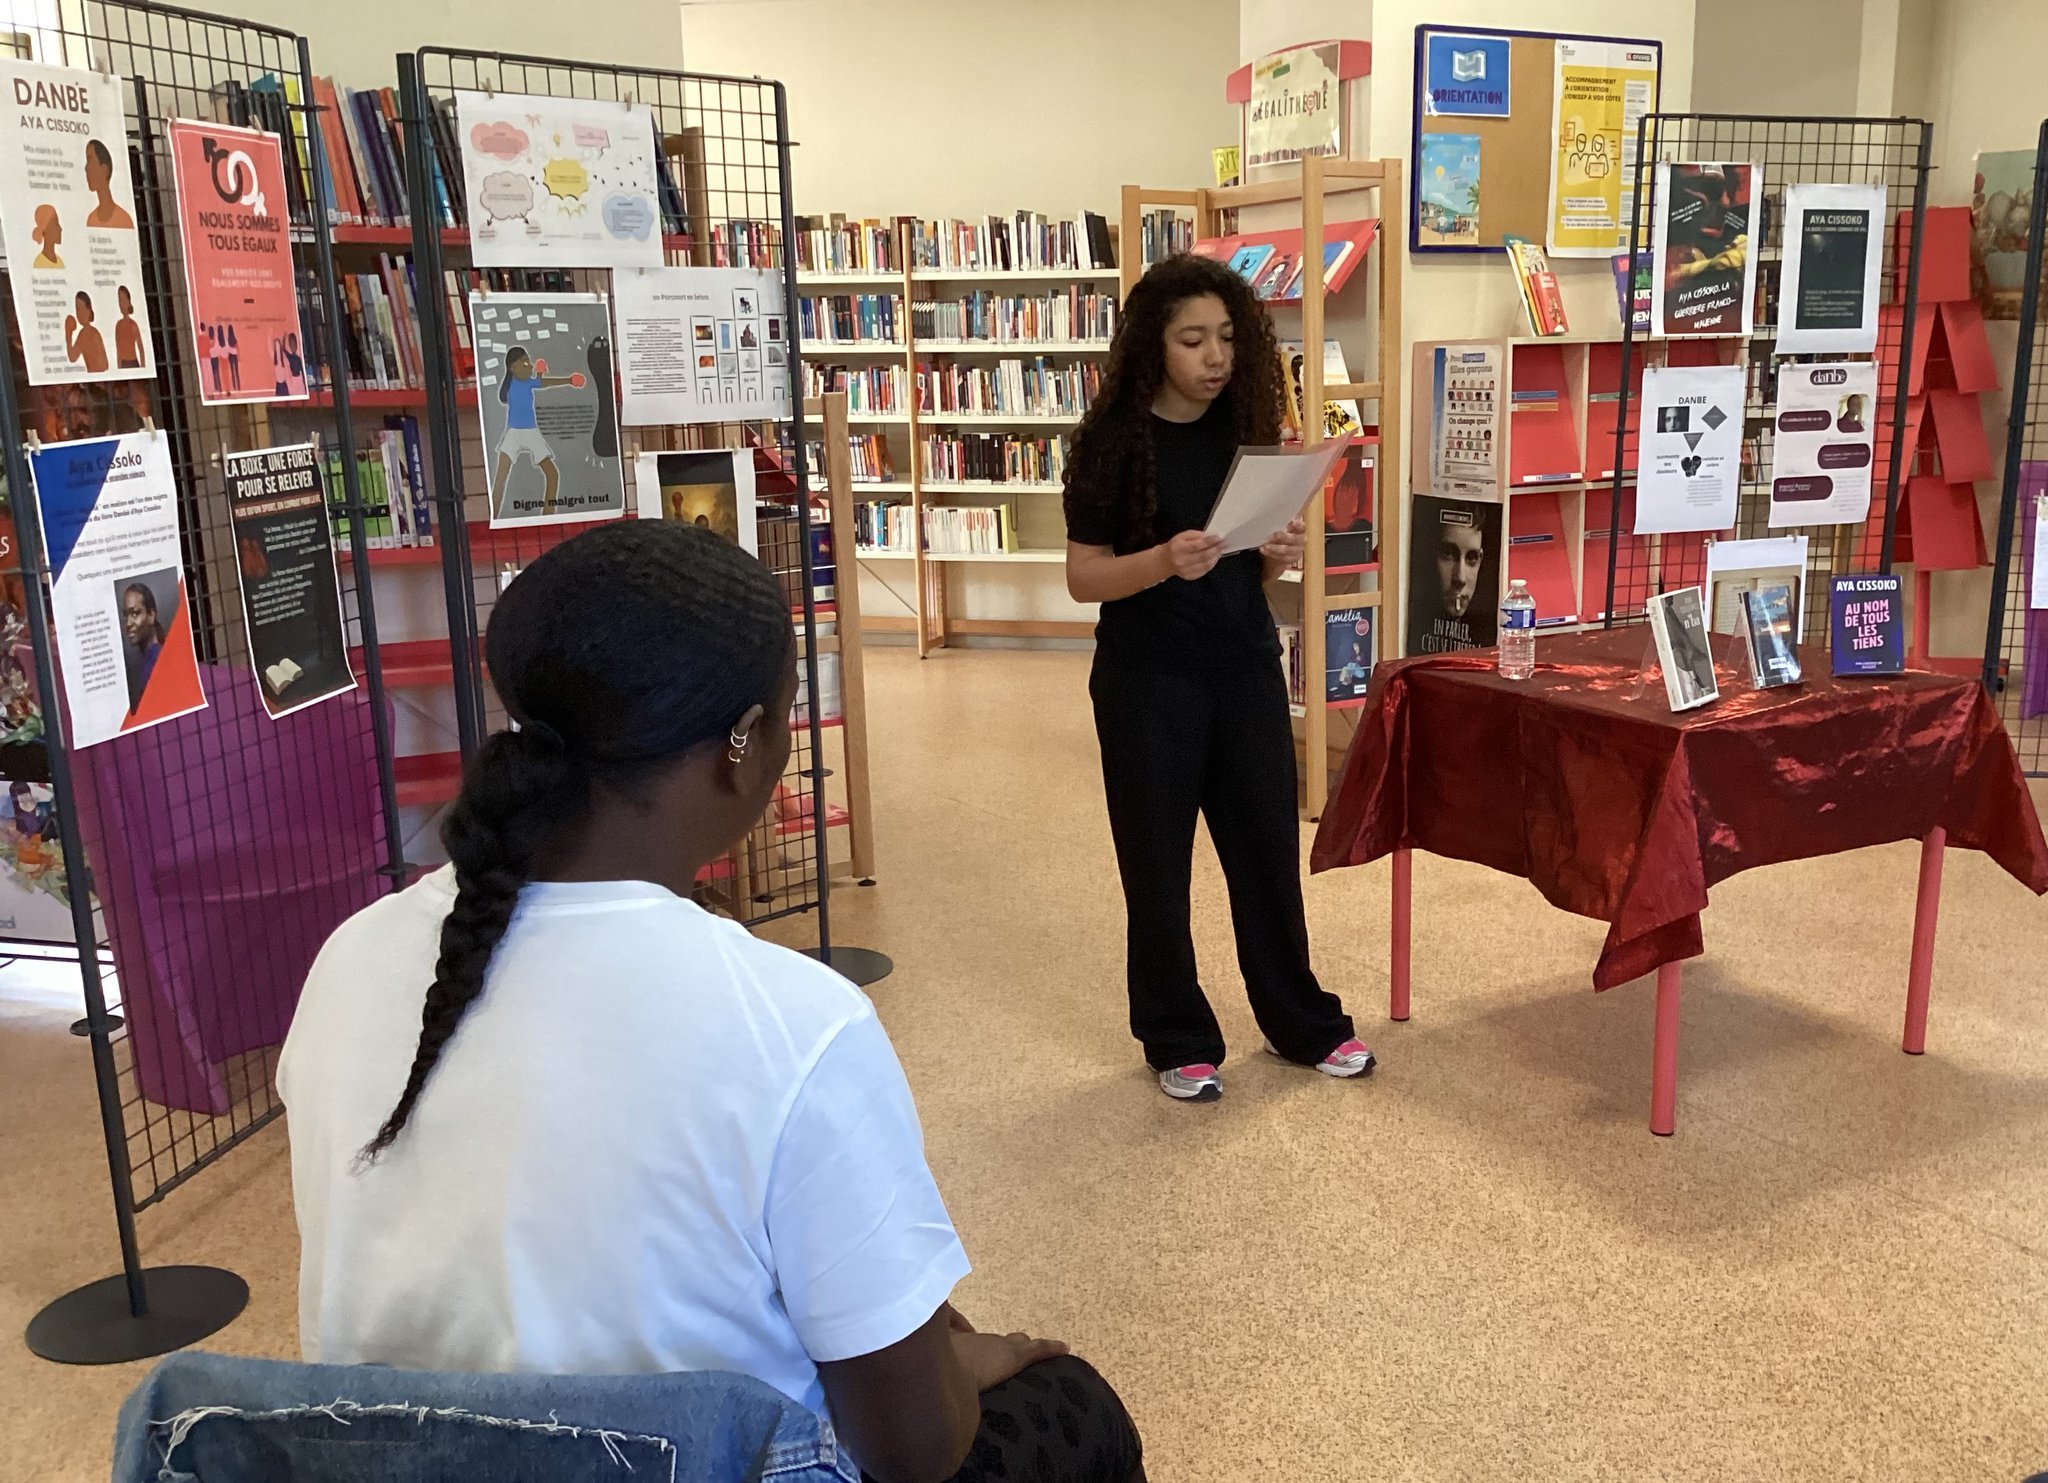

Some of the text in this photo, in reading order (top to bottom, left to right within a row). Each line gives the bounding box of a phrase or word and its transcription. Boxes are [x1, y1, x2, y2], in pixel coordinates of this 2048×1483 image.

[1565, 76, 1617, 85] ACCOMPAGNEMENT
[1570, 85, 1609, 93] L'ORIENTATION
[1433, 89, 1503, 104] ORIENTATION
[20, 115, 90, 136] AYA CISSOKO
[198, 212, 281, 233] NOUS SOMMES
[1810, 215, 1863, 225] AYA CISSOKO
[208, 234, 240, 251] TOUS
[1679, 291, 1692, 304] AYA
[1721, 282, 1730, 291] LA
[1467, 365, 1493, 375] garçons
[96, 451, 142, 471] Cissoko
[226, 449, 314, 478] LA BOXE, UNE FORCE
[236, 471, 314, 499] POUR SE RELEVER
[513, 493, 610, 511] Digne malgré tout
[1836, 579, 1897, 591] AYA CISSOKO
[1845, 599, 1889, 615] AU NOM
[1434, 618, 1444, 636] EN
[1845, 611, 1890, 628] DE TOUS
[1858, 625, 1877, 638] LES
[1852, 635, 1884, 650] TIENS
